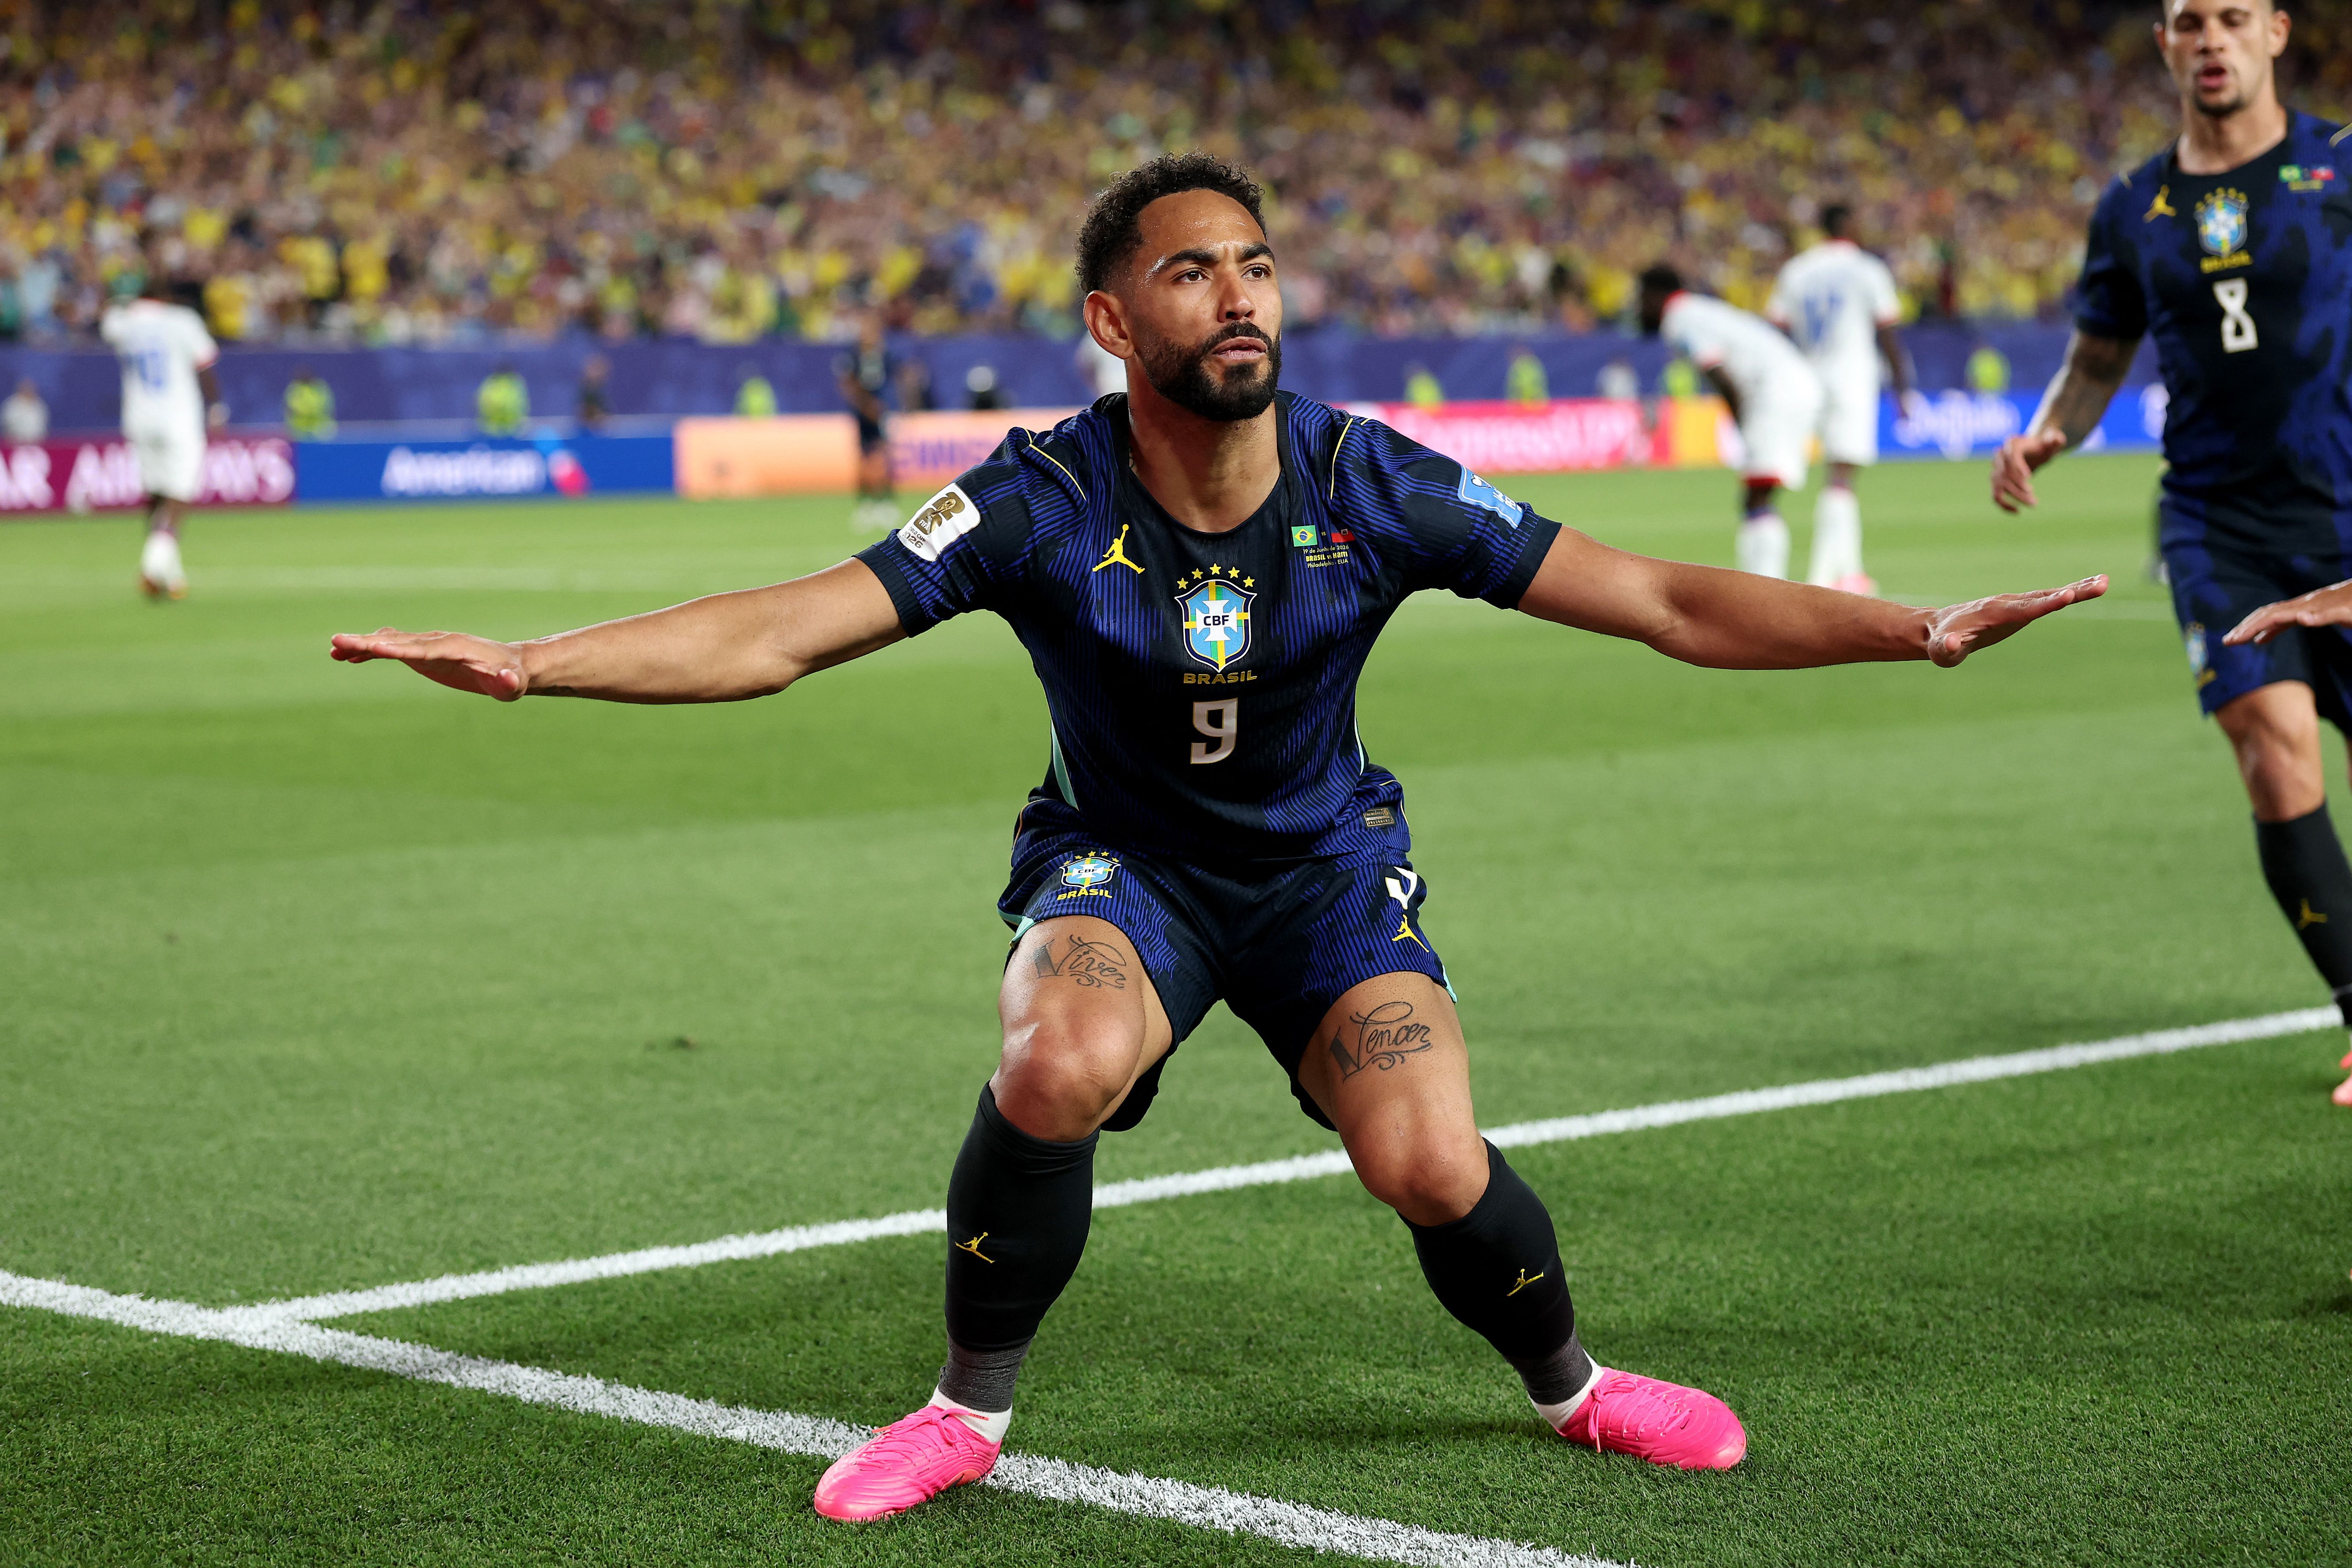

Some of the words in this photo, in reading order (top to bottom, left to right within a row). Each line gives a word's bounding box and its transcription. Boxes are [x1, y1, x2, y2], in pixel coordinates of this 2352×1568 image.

[2212, 277, 2258, 353] 8
[919, 519, 928, 530] FIFA
[902, 531, 923, 548] 026
[917, 534, 925, 542] CUP
[1203, 615, 1229, 626] CBF
[1183, 670, 1257, 684] BRASIL
[1190, 698, 1238, 764] 9
[1057, 888, 1112, 900] BRASIL
